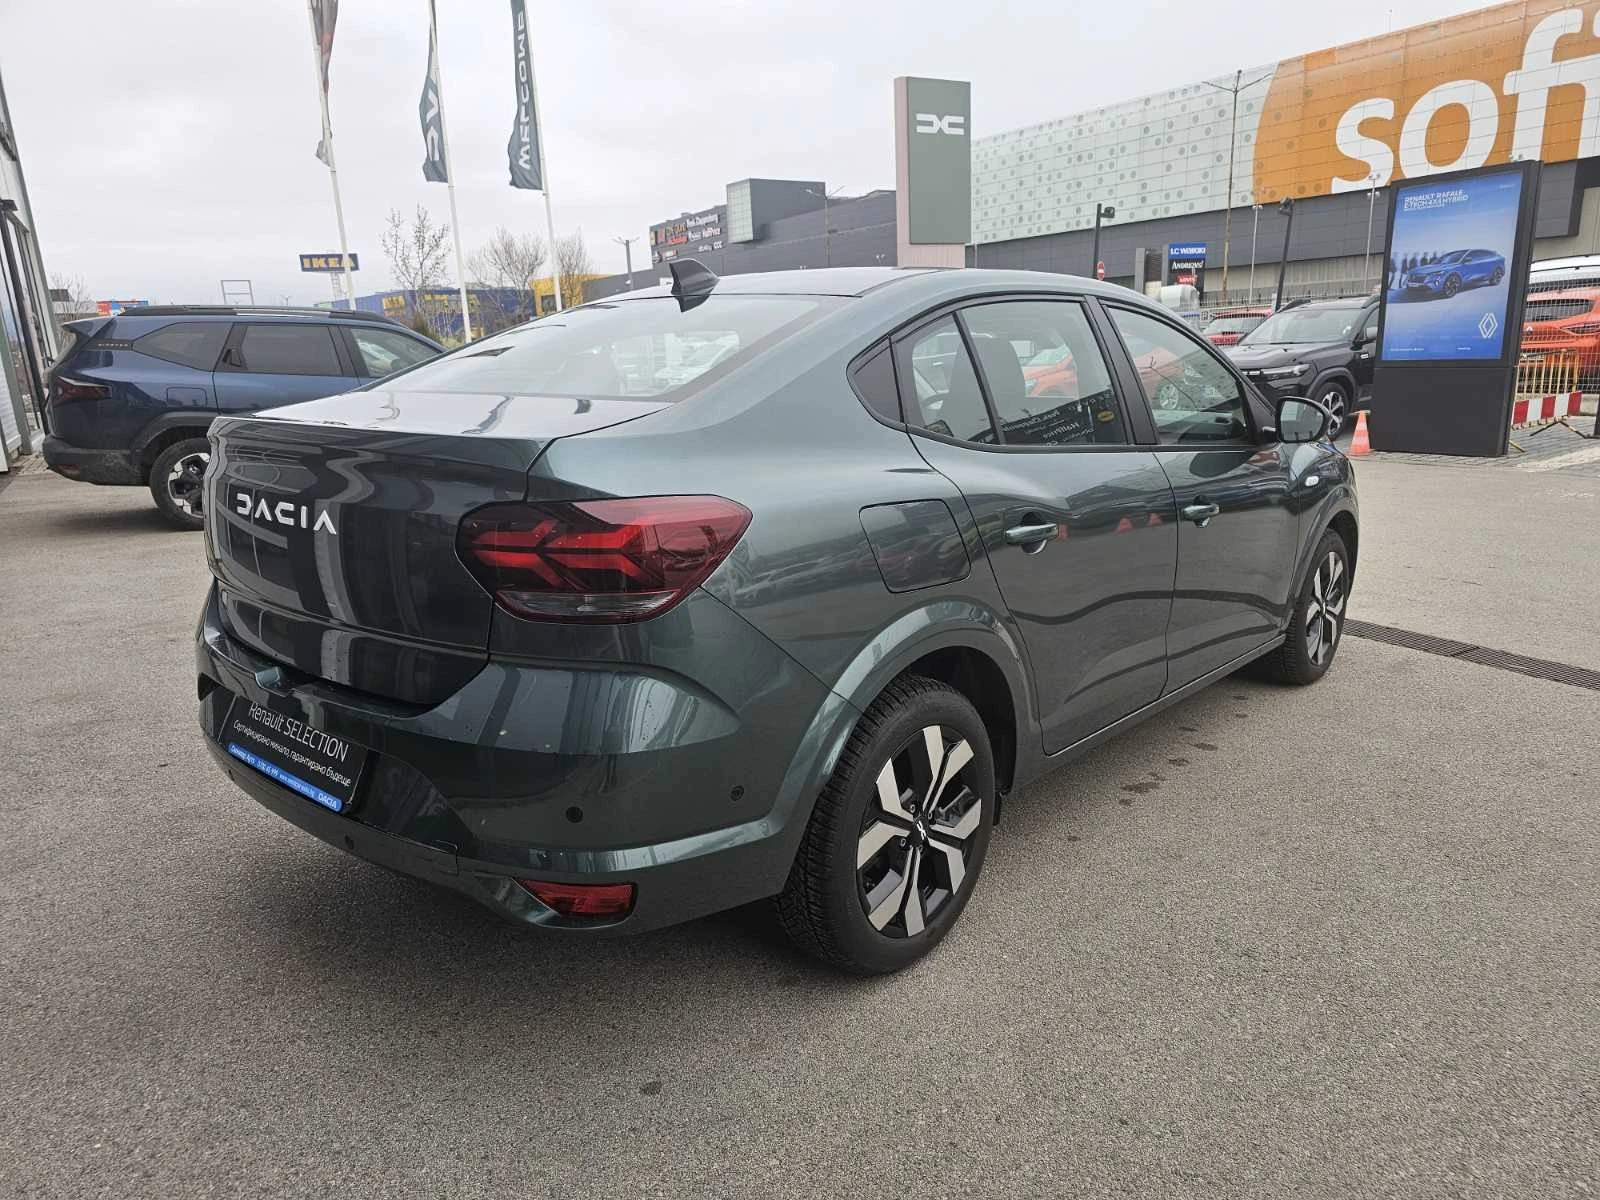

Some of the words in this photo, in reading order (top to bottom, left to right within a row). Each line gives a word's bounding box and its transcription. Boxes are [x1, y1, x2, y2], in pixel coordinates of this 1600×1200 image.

[236, 492, 337, 535] DACIA
[249, 702, 285, 733] Renault
[284, 717, 349, 763] SELECTION
